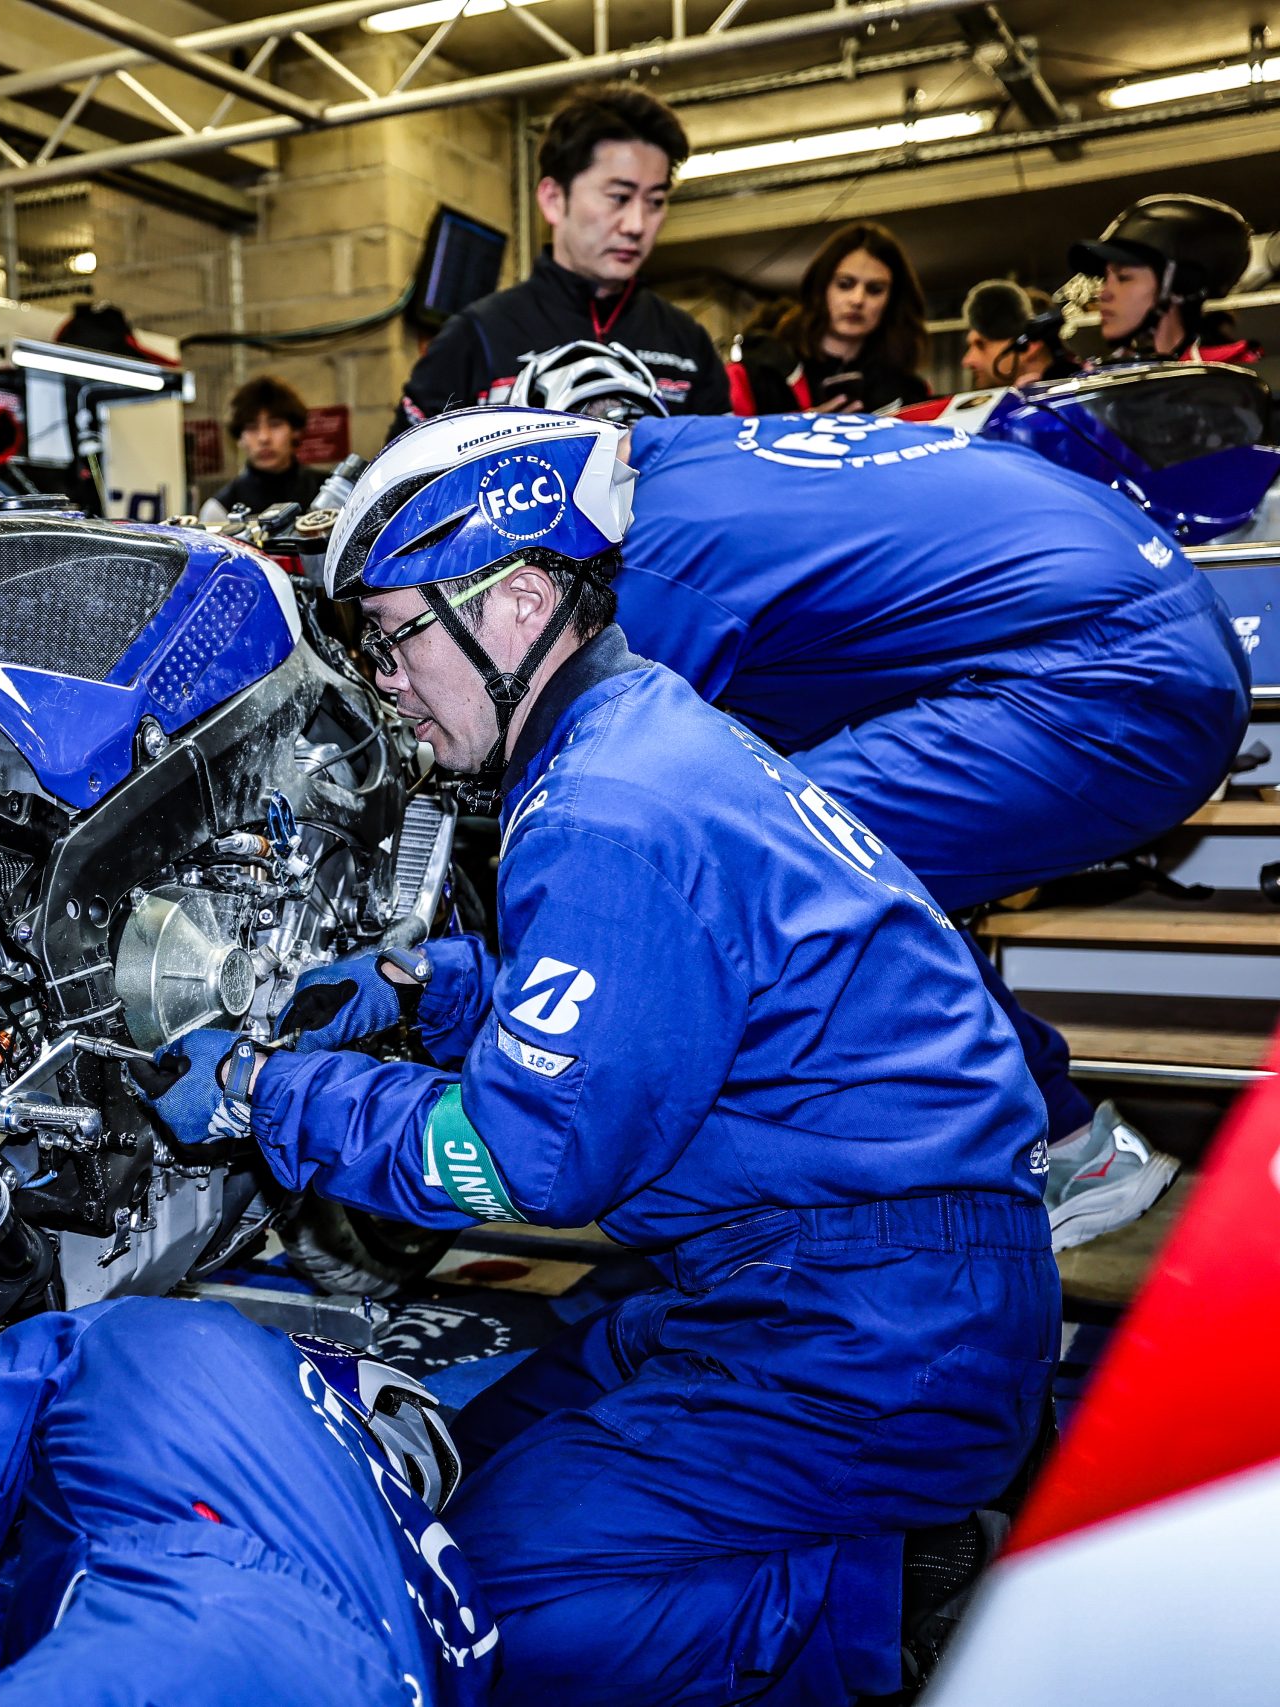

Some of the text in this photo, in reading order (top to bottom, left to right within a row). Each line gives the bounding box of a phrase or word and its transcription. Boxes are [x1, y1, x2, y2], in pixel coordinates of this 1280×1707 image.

[457, 419, 577, 452] Honda France
[480, 455, 551, 488] CLUTCH
[486, 475, 561, 519] F.C.C.
[491, 504, 567, 541] TECHNOLOGY
